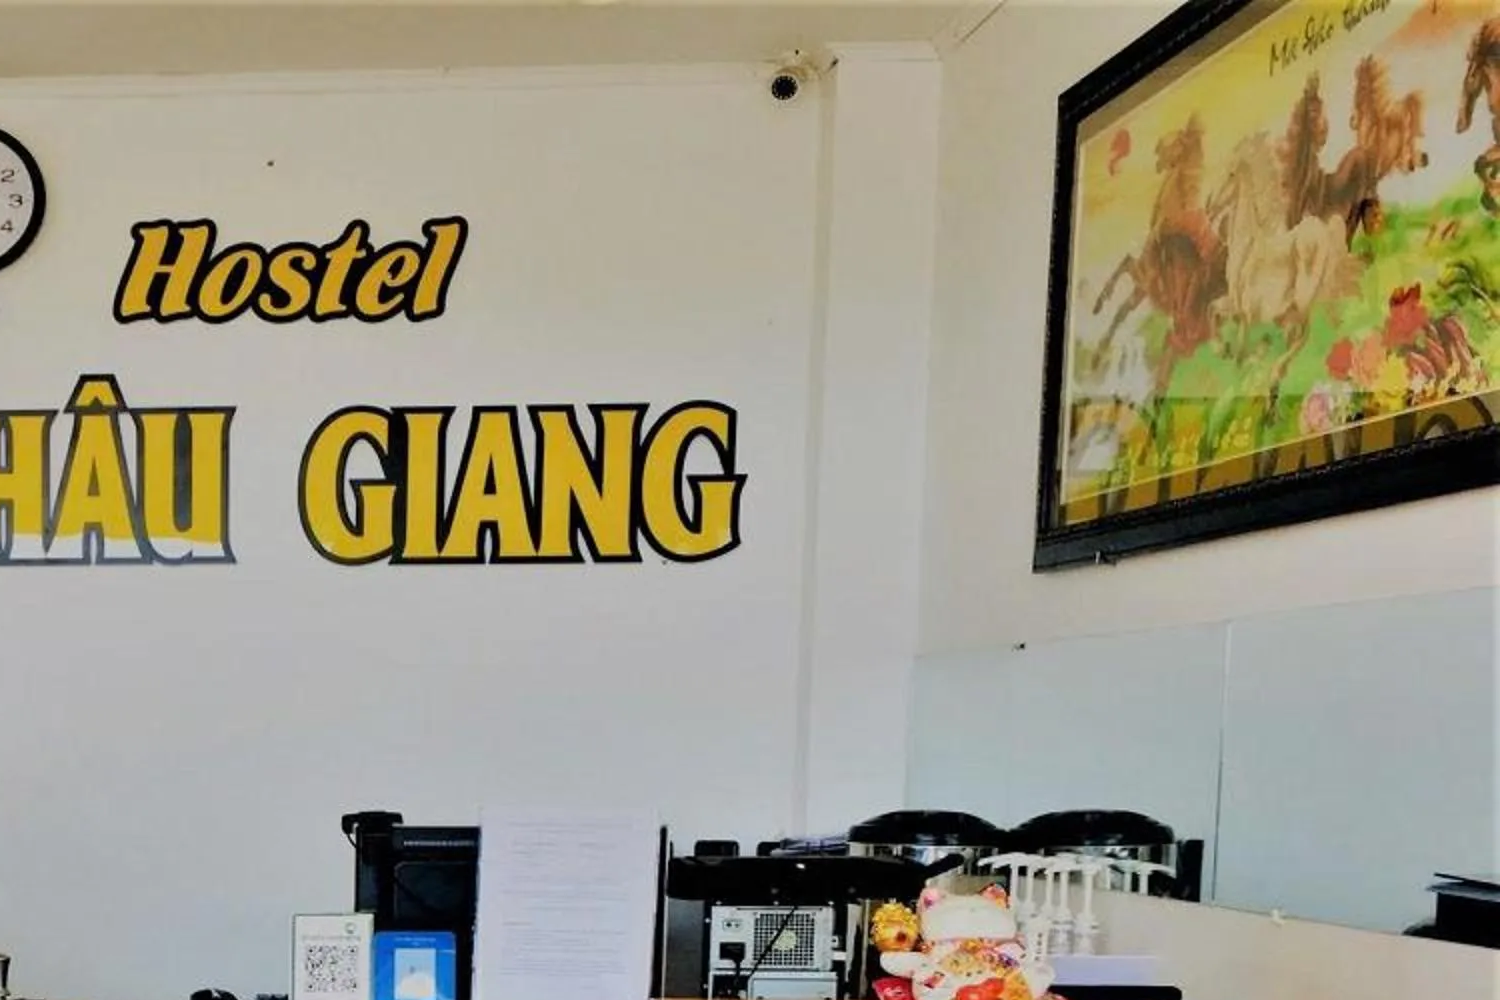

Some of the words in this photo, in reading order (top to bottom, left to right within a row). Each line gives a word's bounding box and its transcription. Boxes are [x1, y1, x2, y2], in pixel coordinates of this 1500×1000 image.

[0, 169, 15, 183] 2
[9, 194, 23, 208] 3
[0, 219, 14, 233] 4
[112, 215, 470, 325] Hostel
[297, 400, 749, 566] GIANG
